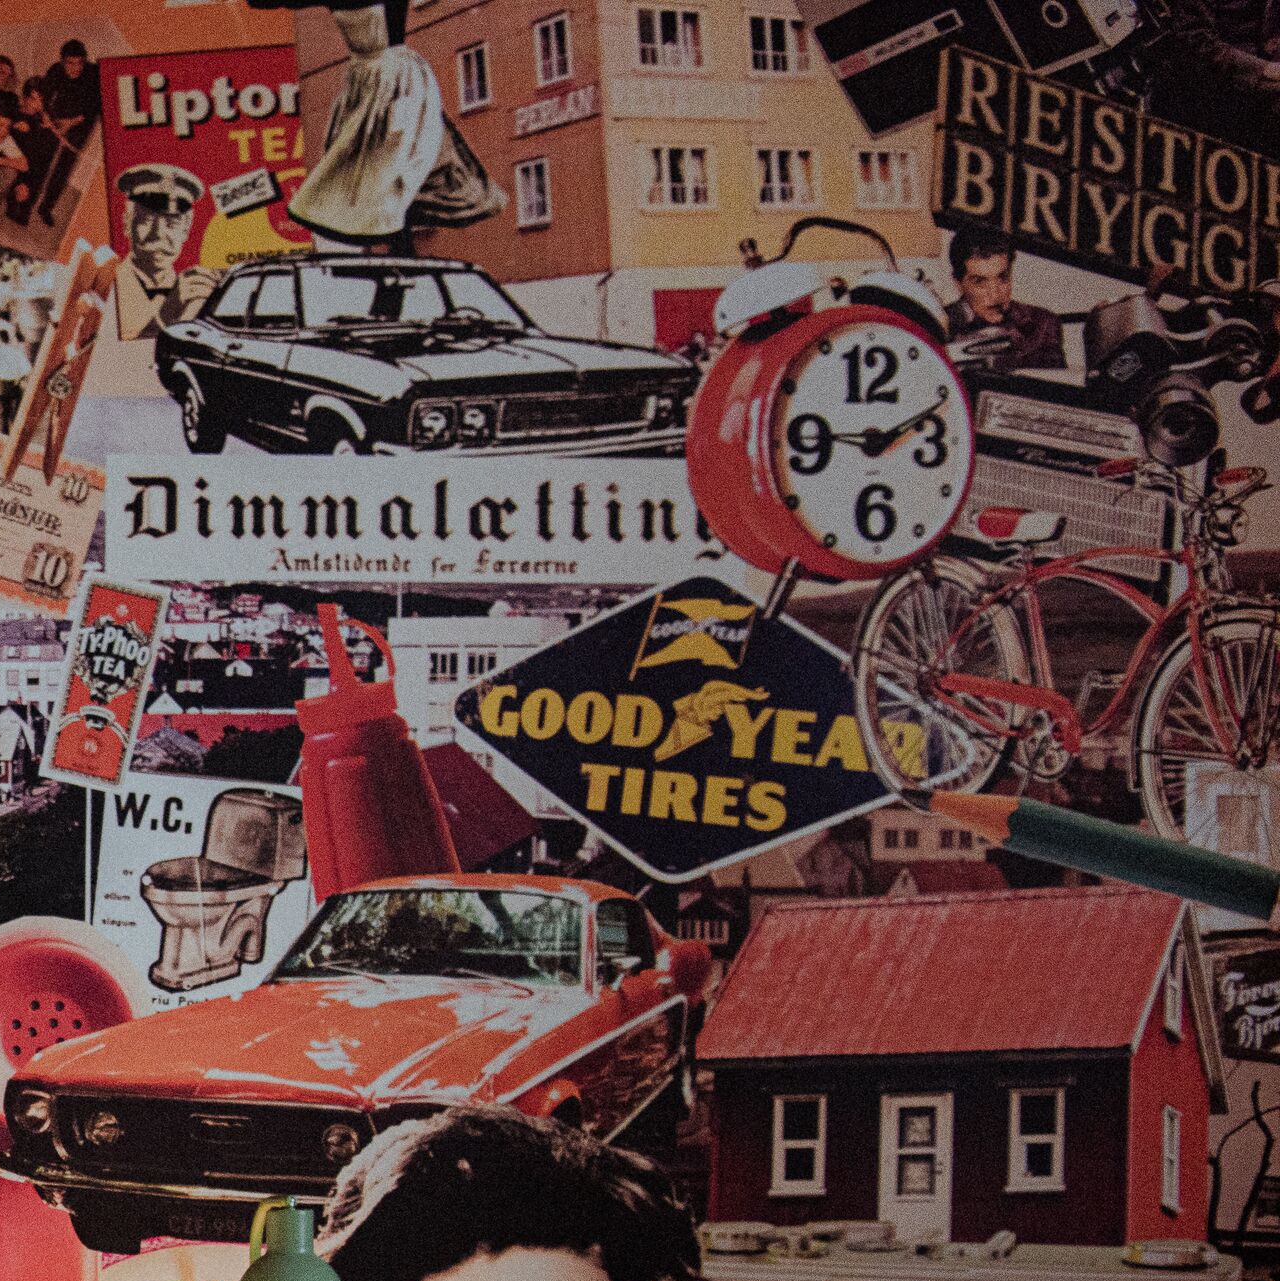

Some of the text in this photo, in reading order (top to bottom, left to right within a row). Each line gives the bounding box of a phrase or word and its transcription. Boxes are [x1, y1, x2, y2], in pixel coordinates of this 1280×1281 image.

[955, 140, 1280, 292] BRYGG
[842, 344, 900, 404] 12
[787, 413, 833, 476] 9
[913, 413, 947, 468] 3
[855, 484, 896, 542] 6
[32, 547, 72, 590] 10
[92, 655, 126, 679] TEA
[114, 792, 193, 834] W.C.
[580, 762, 787, 832] TIRES
